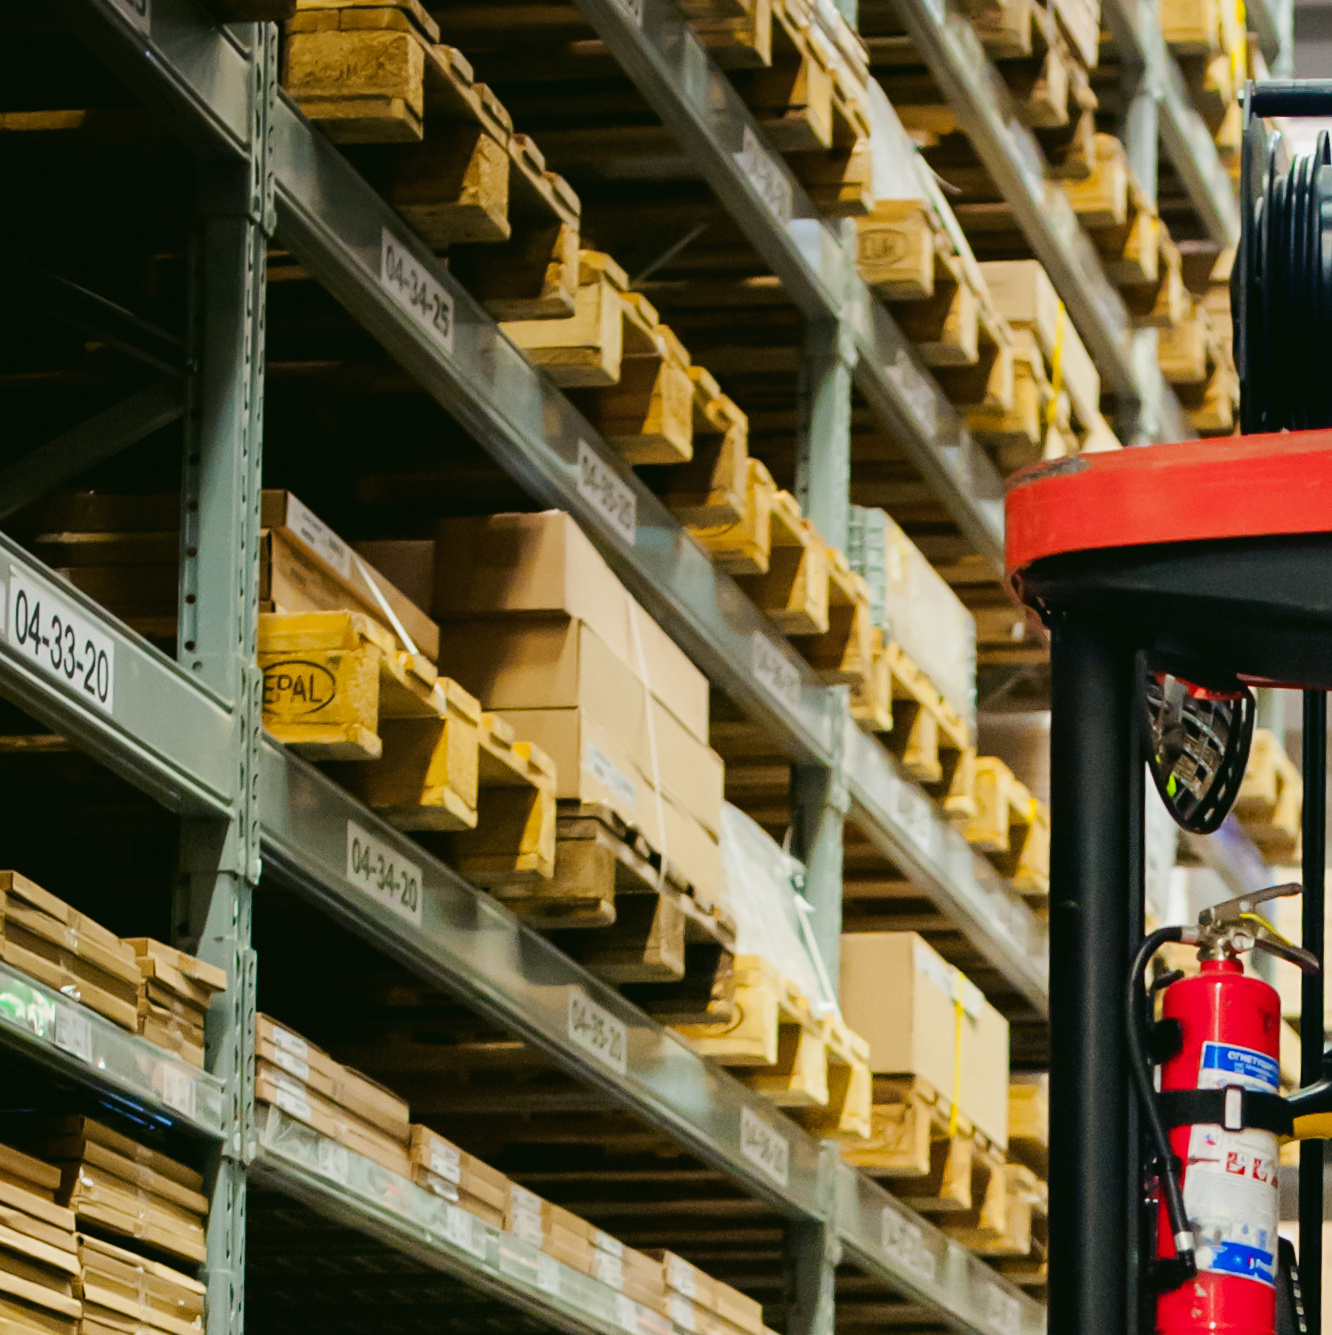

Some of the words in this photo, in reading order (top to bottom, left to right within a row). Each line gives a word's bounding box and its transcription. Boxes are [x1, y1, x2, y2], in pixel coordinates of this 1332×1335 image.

[386, 244, 449, 337] 04-34-25
[15, 588, 109, 703] 04-33-20
[262, 673, 323, 703] EPAL
[352, 837, 418, 913] 04-34-20
